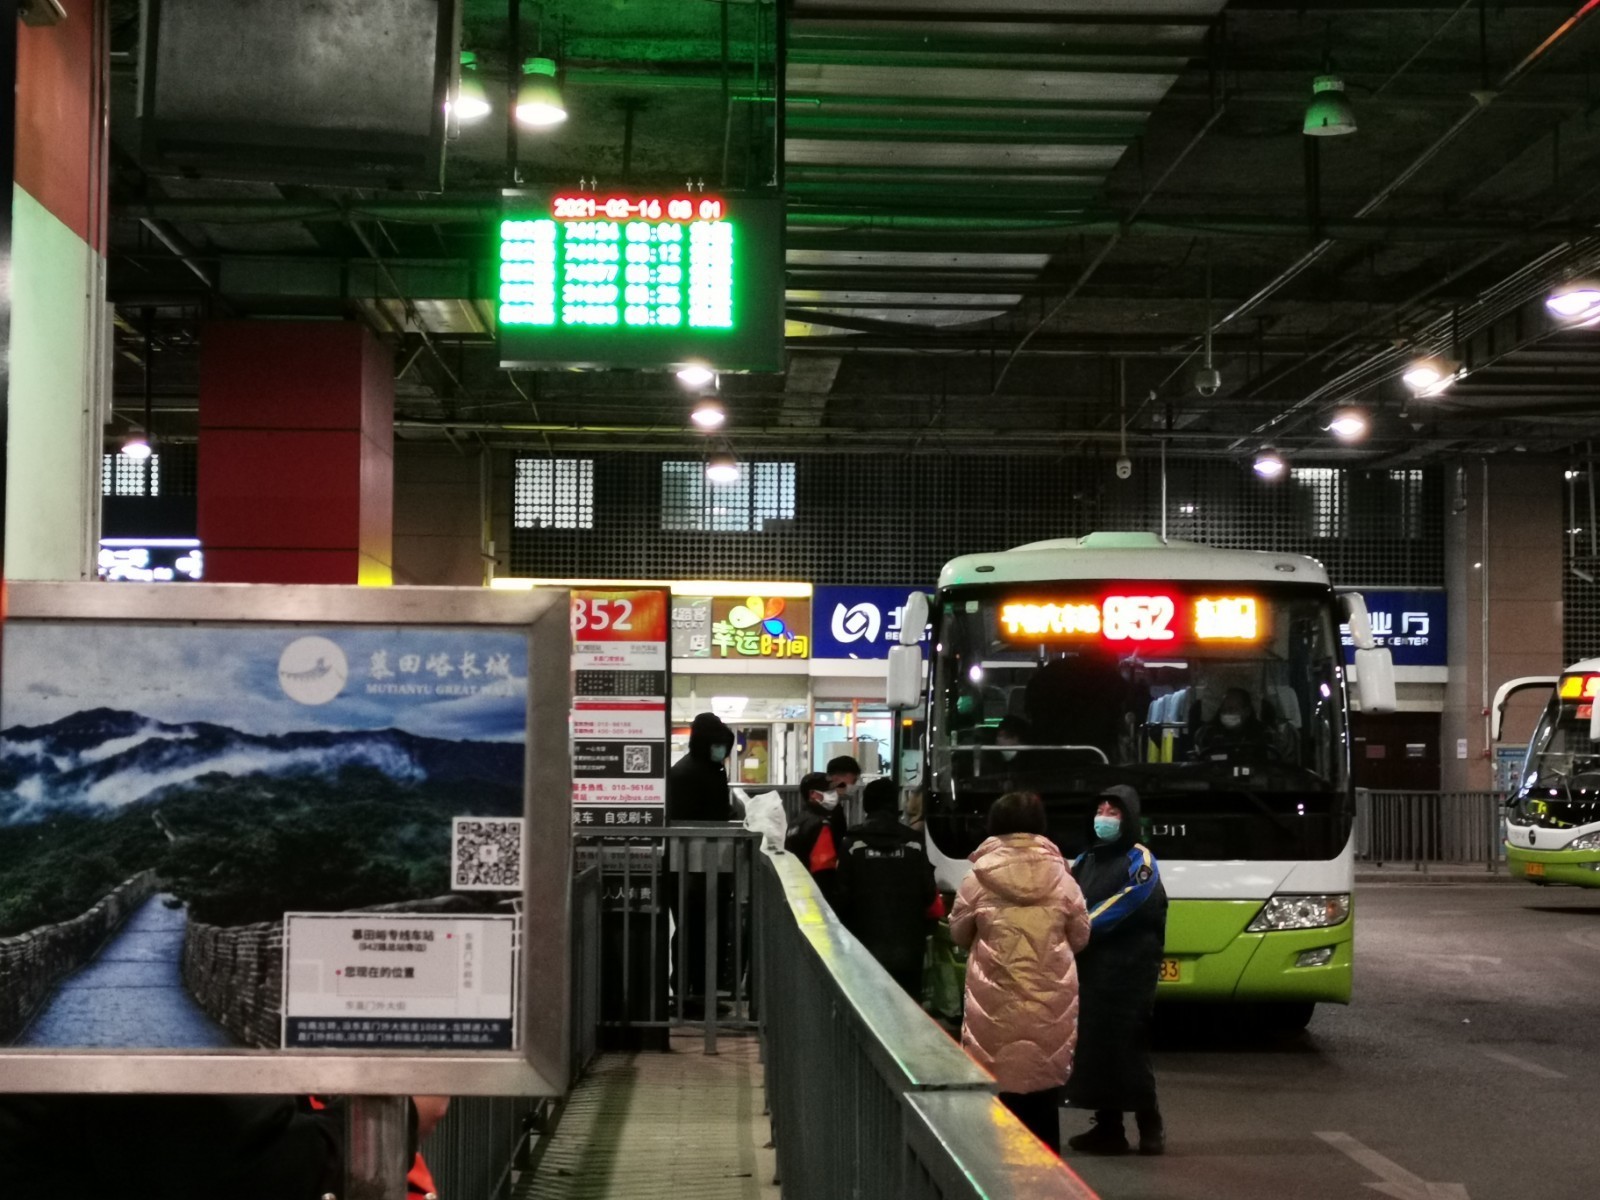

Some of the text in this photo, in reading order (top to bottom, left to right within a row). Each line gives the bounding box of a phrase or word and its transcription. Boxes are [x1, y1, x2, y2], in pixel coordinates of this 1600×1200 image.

[1103, 596, 1175, 640] 852
[1339, 611, 1430, 635] 业厅
[711, 620, 809, 658] 幸运时间
[1388, 636, 1429, 646] CENTER
[366, 683, 431, 695] MUTIANYU
[435, 684, 476, 696] GREAT
[611, 784, 654, 792] 010-96166
[596, 794, 661, 803] www.bjbus.com
[604, 811, 653, 824] 自觉刷卡
[344, 966, 415, 978] 您现在的位置
